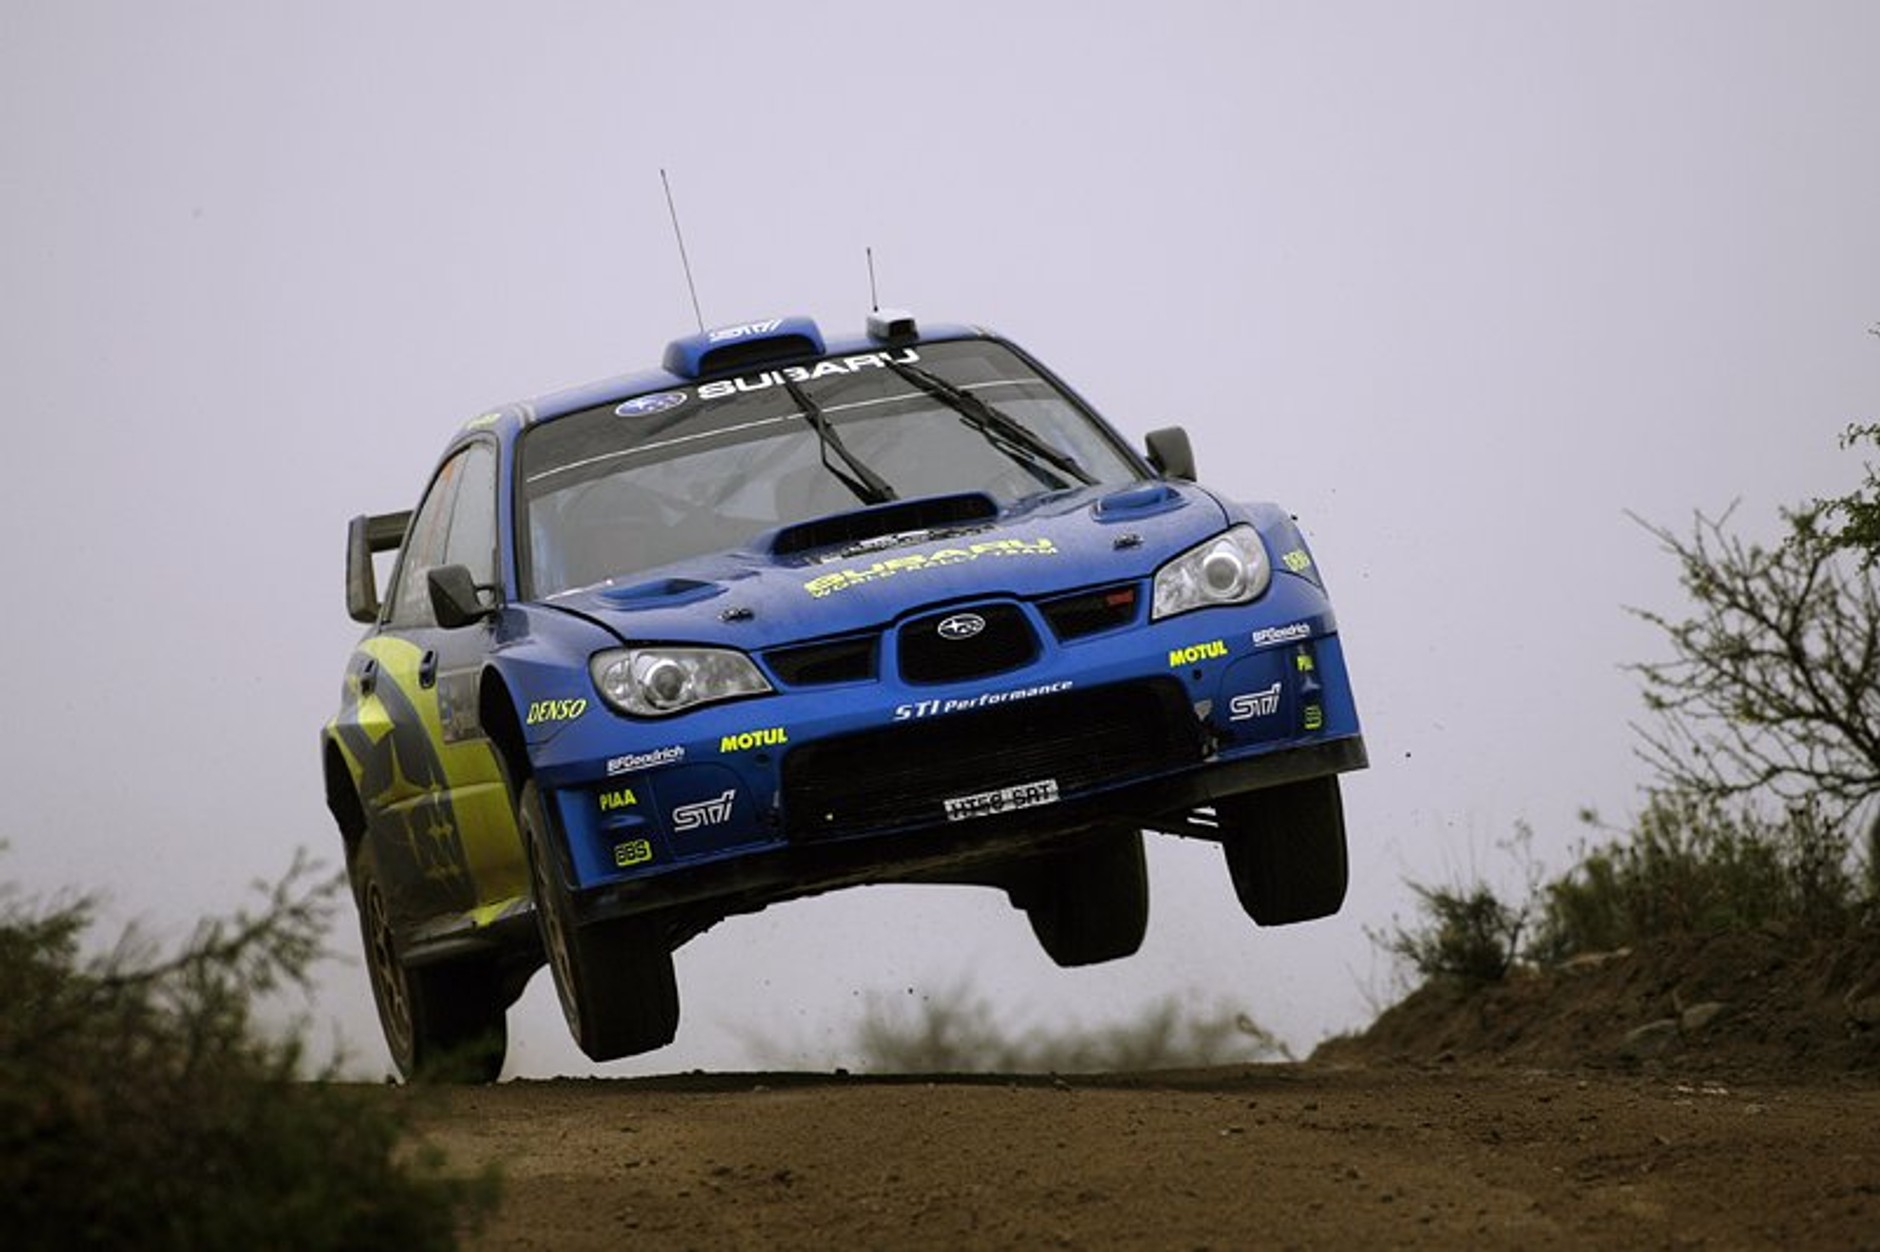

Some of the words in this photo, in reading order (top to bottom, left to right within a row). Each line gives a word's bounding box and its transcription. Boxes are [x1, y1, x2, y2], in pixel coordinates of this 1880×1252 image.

[697, 348, 920, 400] SUBARU
[804, 537, 1052, 592] SUBARU
[1169, 638, 1229, 669] MOTUL
[526, 697, 588, 725] DENSO
[893, 700, 942, 722] STI
[944, 680, 1074, 713] Performance
[719, 727, 788, 754] MOTUL
[606, 745, 685, 773] BFGoodrich
[599, 788, 637, 813] PIAA
[614, 840, 653, 868] BBS
